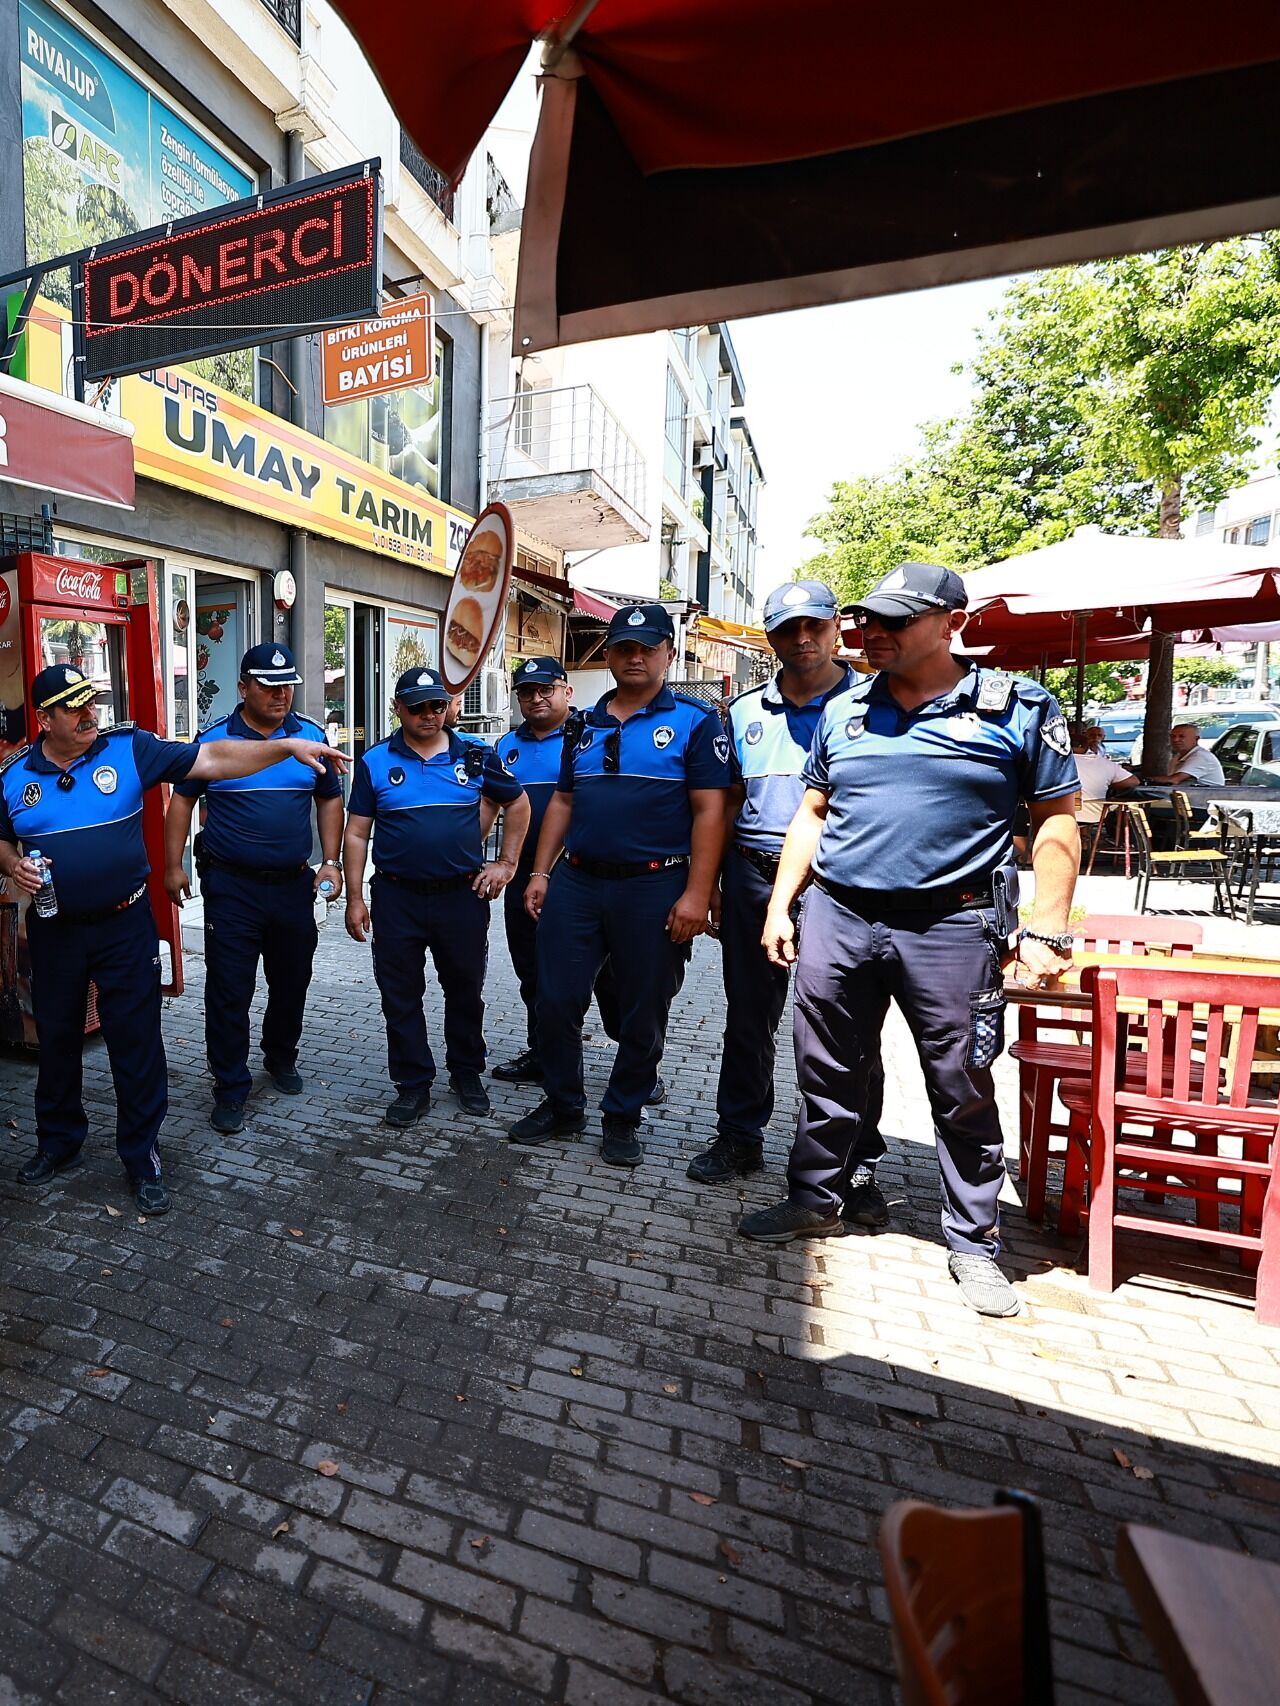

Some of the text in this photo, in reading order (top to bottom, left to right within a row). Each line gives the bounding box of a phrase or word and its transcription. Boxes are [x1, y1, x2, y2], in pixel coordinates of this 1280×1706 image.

[27, 26, 96, 102] RIVALUP
[79, 133, 121, 184] AFC
[160, 125, 192, 166] Zengin
[108, 200, 344, 319] DÖNERCİ
[327, 307, 422, 345] BİTKİ KORUMA
[341, 329, 408, 362] ÜRÜNLERİ
[338, 348, 413, 391] BAYİSİ
[164, 396, 433, 549] UMAY TARIM
[56, 567, 104, 601] Coca-Cola
